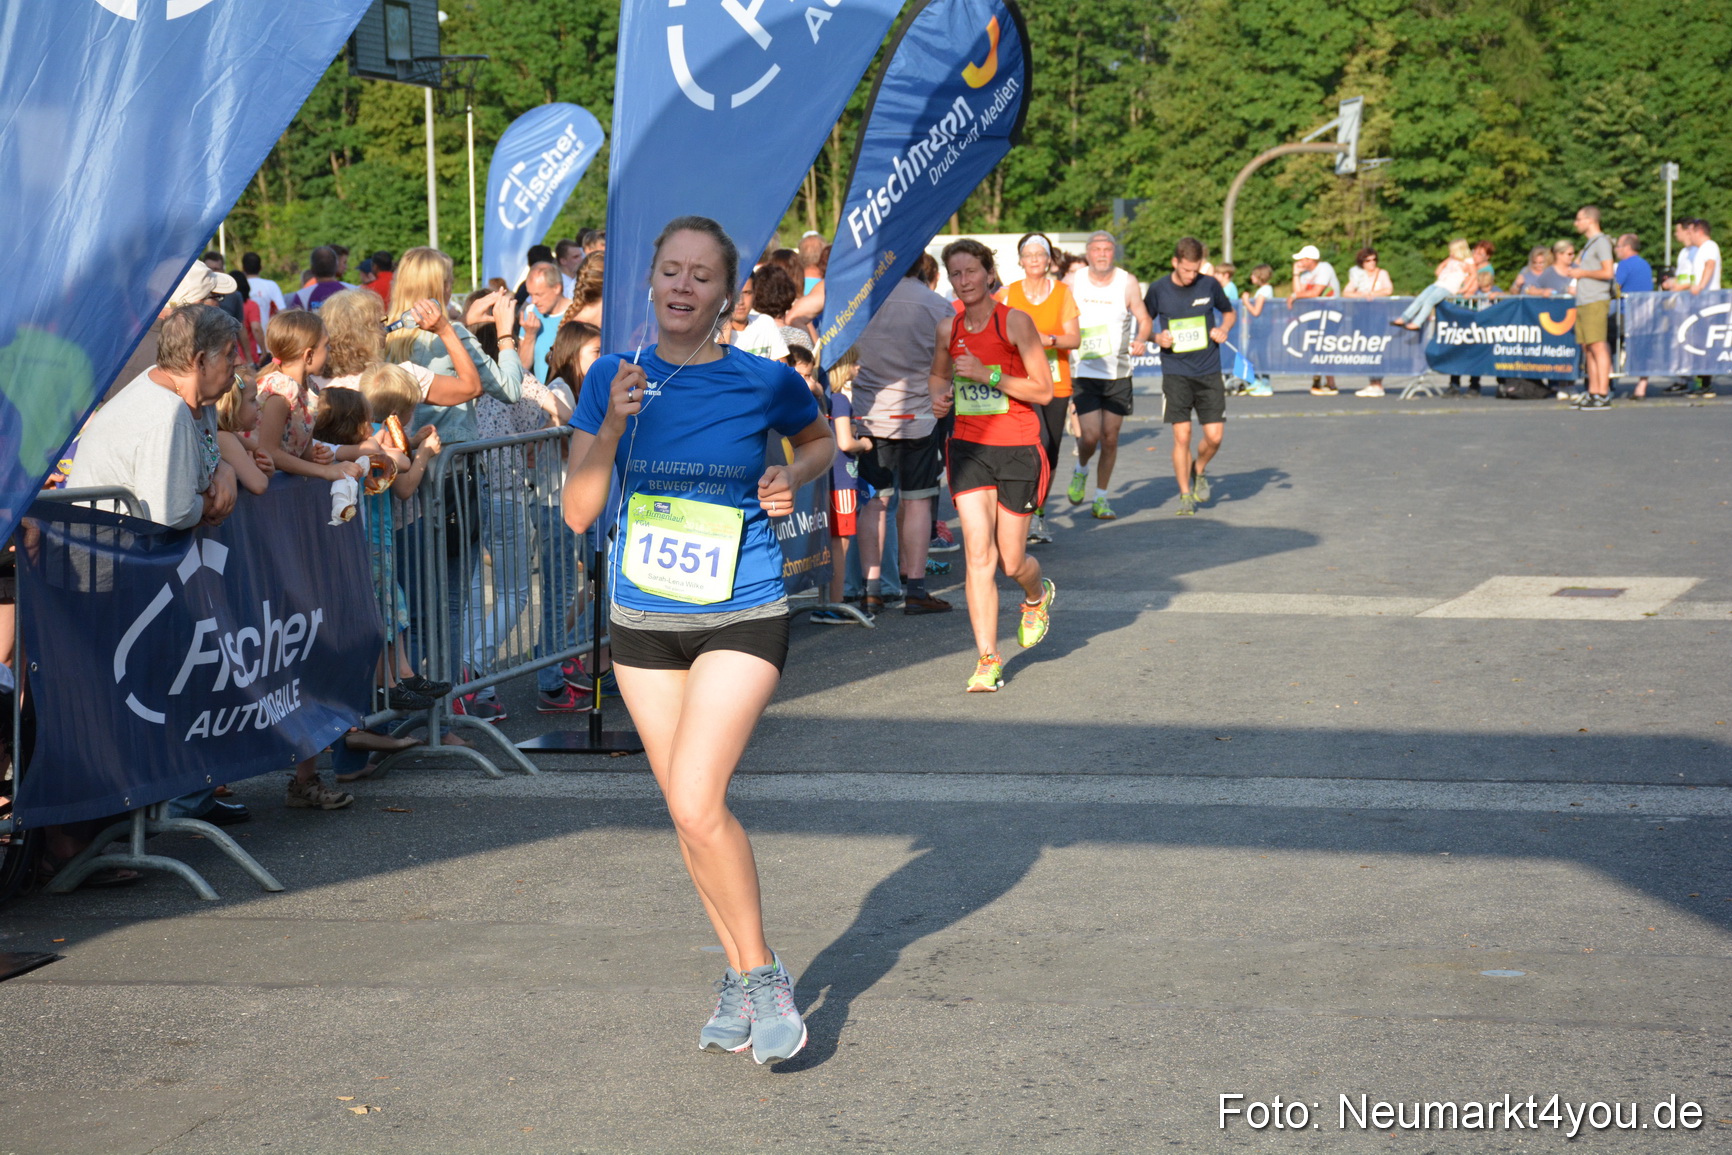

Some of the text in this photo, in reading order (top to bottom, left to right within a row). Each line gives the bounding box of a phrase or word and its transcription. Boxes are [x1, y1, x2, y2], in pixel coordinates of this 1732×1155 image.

[928, 146, 961, 186] Druck
[981, 76, 1020, 132] Medien
[513, 123, 577, 214] Fischer
[847, 95, 975, 249] Frischmann
[1082, 338, 1102, 351] 557
[1177, 331, 1200, 343] 699
[1302, 329, 1392, 353] Fischer
[1436, 321, 1542, 345] Frischmann
[1310, 353, 1383, 365] AUTOMOBILE
[1492, 343, 1576, 357] Druck und Medien
[651, 460, 704, 476] LAUFEND
[709, 464, 747, 480] DENKT,
[648, 479, 727, 496] BEWEGT SICH
[776, 514, 796, 541] und
[638, 533, 721, 578] 1551
[168, 599, 323, 696] Fischer
